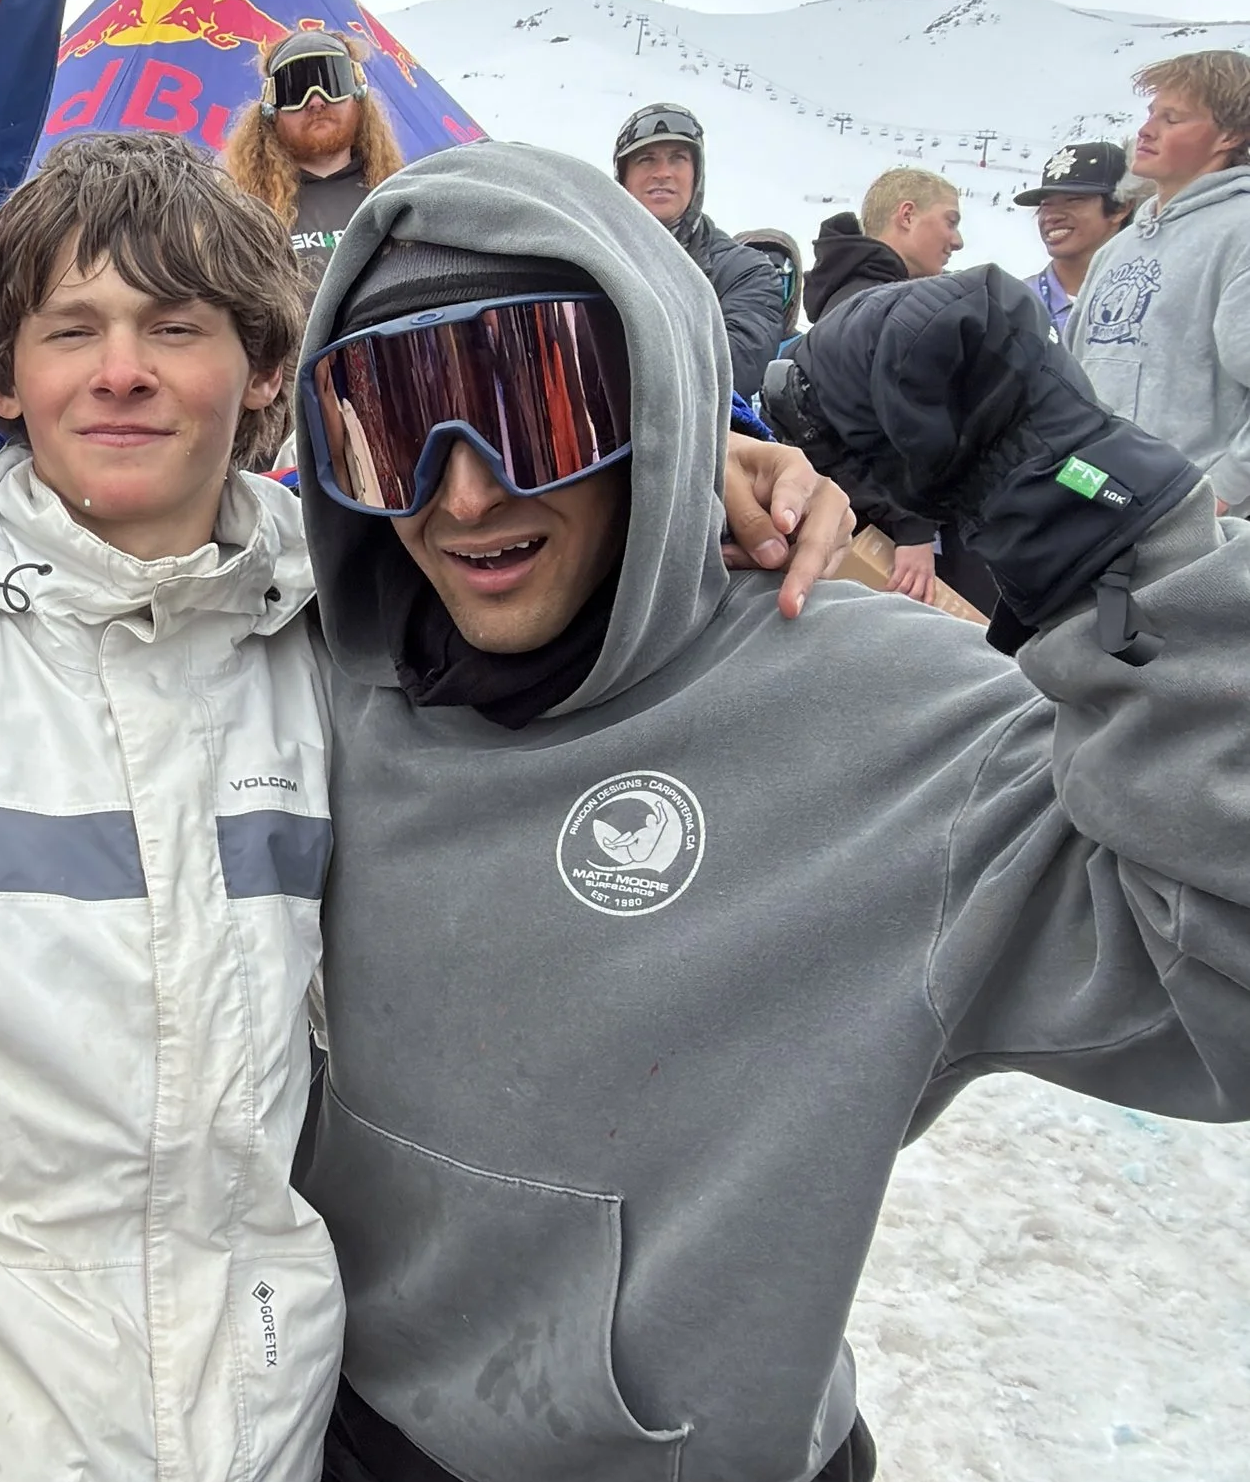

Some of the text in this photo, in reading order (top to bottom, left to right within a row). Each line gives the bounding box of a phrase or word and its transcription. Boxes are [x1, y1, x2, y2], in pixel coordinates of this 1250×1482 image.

[1103, 489, 1127, 505] 10K
[229, 776, 298, 792] VOLCOM
[569, 798, 598, 835] RINCON
[597, 779, 642, 801] DESIGNS
[686, 834, 696, 850] CA
[572, 868, 669, 893] MATT MOORE
[585, 880, 655, 897] SURFBOARDS
[260, 1305, 277, 1367] GORE-TEX
